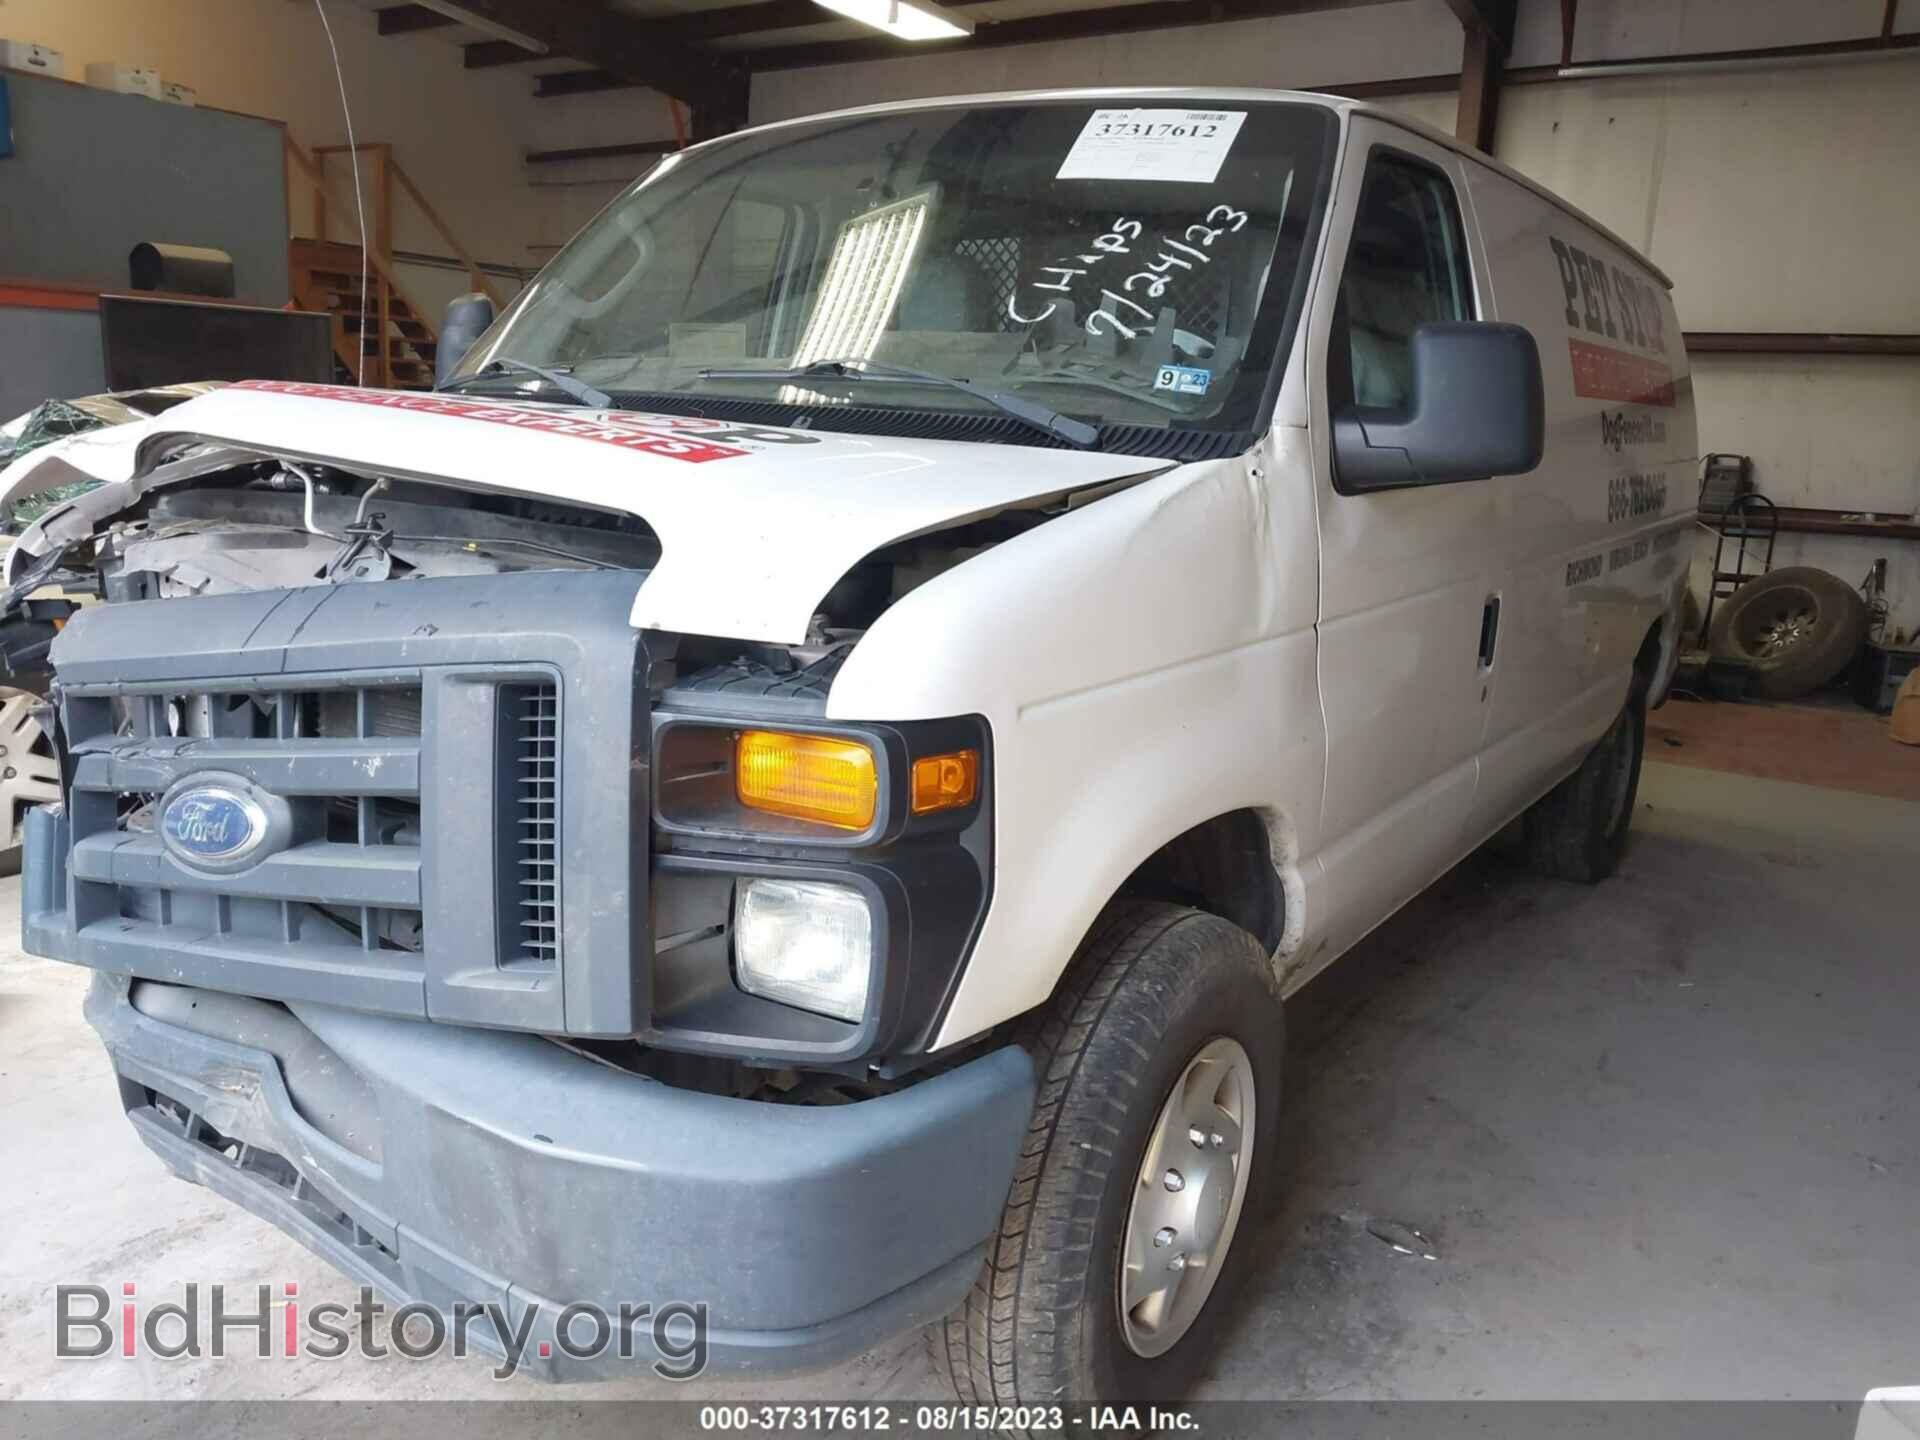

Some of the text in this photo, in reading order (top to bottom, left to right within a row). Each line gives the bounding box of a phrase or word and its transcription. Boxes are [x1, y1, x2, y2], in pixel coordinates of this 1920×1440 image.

[1095, 123, 1217, 138] 37317612
[1550, 236, 1617, 339] PET
[1161, 370, 1174, 386] 9
[1191, 374, 1208, 386] 23
[463, 408, 706, 455] EXPERTS
[177, 801, 231, 842] Ford
